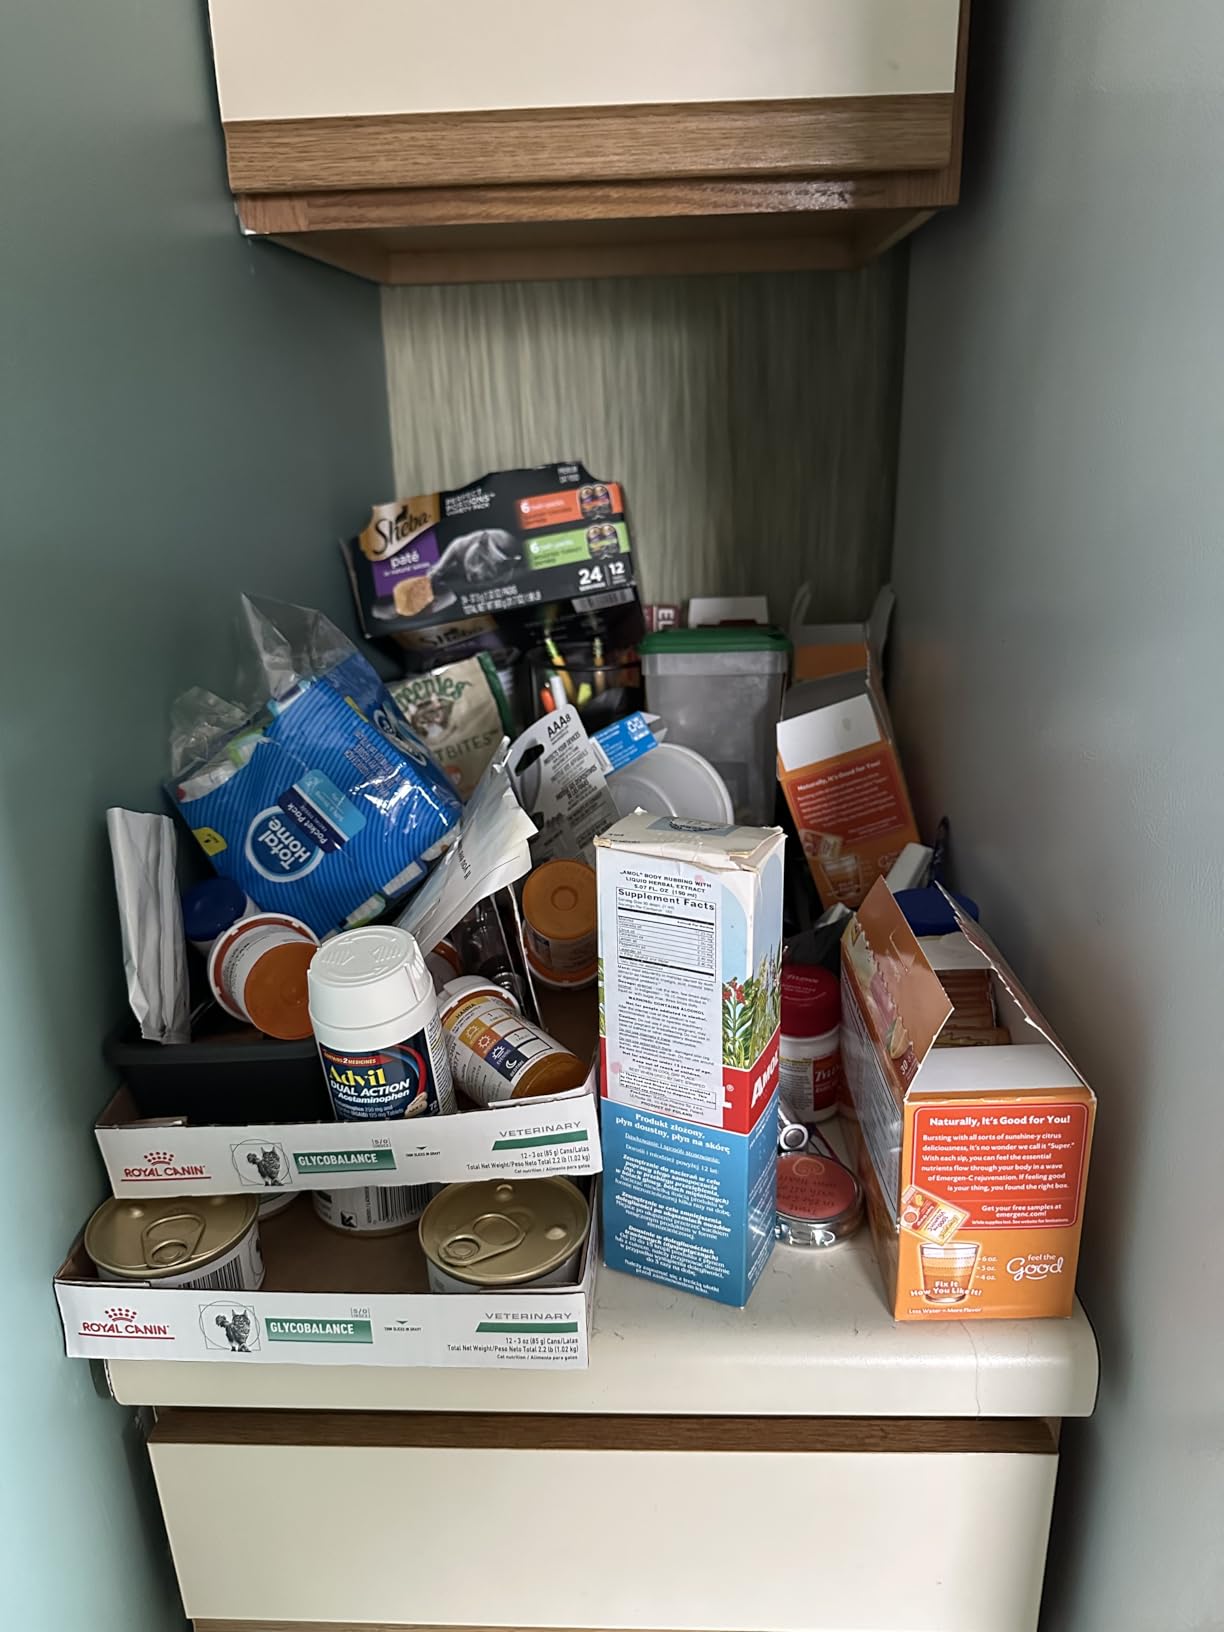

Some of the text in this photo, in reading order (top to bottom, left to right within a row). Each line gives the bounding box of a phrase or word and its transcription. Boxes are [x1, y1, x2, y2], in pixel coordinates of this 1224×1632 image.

[520, 502, 530, 513] 6
[372, 512, 430, 555] Sheba
[530, 543, 540, 554] 6
[578, 566, 603, 585] 24
[608, 562, 625, 576] 12
[288, 803, 328, 844] Pocket Pack
[268, 818, 311, 862] Home
[258, 830, 295, 870] Total
[626, 876, 705, 893] LIQUID HERBAL EXTRACT
[618, 888, 680, 905] Supplement
[684, 898, 714, 910] Facts
[330, 1065, 386, 1086] Advil
[330, 1078, 410, 1096] DUAL ACTION
[338, 1090, 410, 1104] Acetaminophen
[636, 1113, 668, 1128] Produkt
[930, 1115, 1070, 1128] Naturally, It's Good for You!
[499, 1120, 581, 1138] VETERINARY
[616, 1116, 730, 1155] płyn doustny, płyn na skórę
[922, 1134, 952, 1142] Bursting
[1005, 1133, 1040, 1141] sunshine-y
[560, 1146, 590, 1155] Cans/Latas
[922, 1144, 968, 1152] deliciousness,
[298, 1153, 378, 1166] GLYCOBALANCE
[492, 1161, 524, 1169] Weight/Peso
[538, 1158, 552, 1166] Total
[582, 1154, 590, 1162] kg)
[958, 1154, 968, 1162] sip,
[124, 1166, 204, 1178] ROYAL CANIN
[970, 1164, 997, 1172] through
[928, 1174, 935, 1182] of
[974, 1174, 1018, 1182] rejuvenation.
[970, 1184, 990, 1192] thing,
[996, 1210, 1046, 1218] emergenc.com!
[1027, 1204, 1054, 1212] samples
[1006, 1256, 1064, 1281] Good
[970, 1288, 982, 1296] It!
[485, 1312, 572, 1320] VETERINARY
[82, 1322, 167, 1334] ROYAL CANIN
[270, 1322, 354, 1334] GLYCOBALANCE
[473, 1345, 508, 1353] Weight/Peso
[554, 1346, 568, 1354] (1.02
[570, 1346, 578, 1354] kg)
